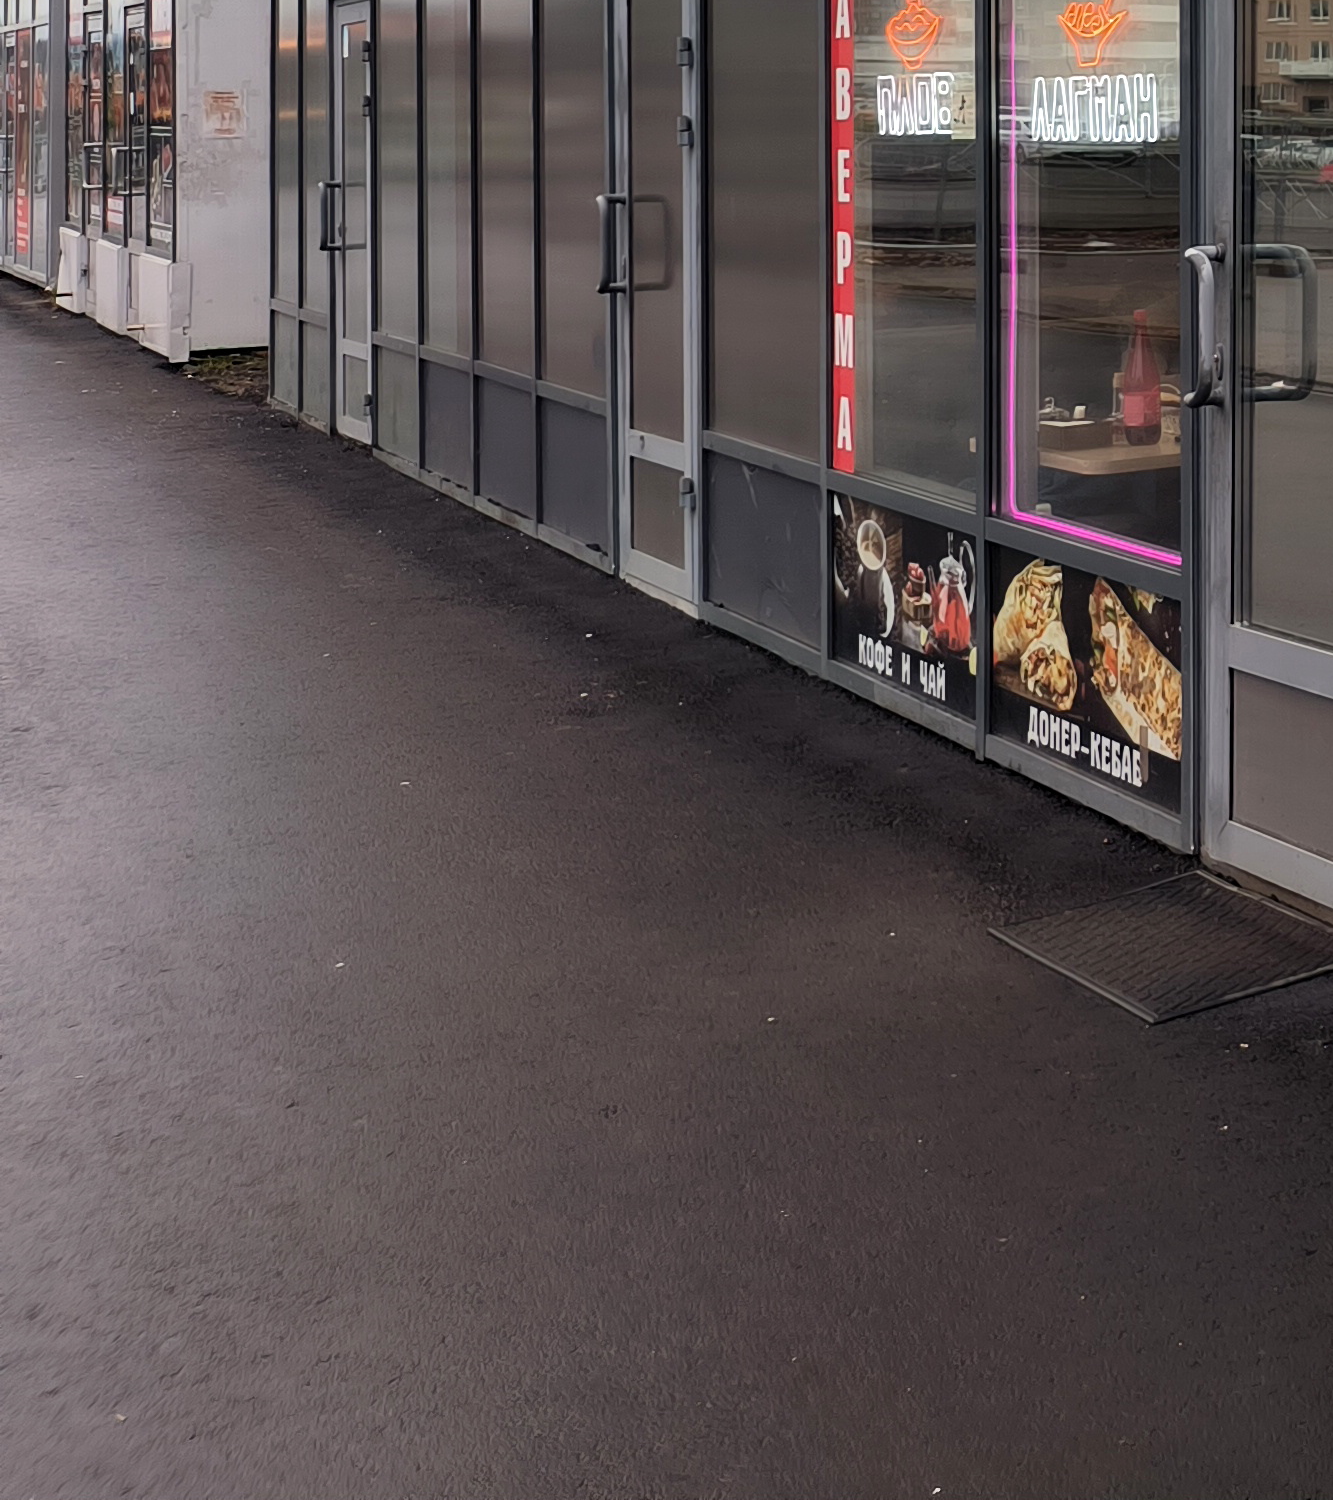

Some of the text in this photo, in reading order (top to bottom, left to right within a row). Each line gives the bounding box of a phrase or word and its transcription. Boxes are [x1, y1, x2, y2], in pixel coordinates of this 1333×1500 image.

[1031, 74, 1158, 143] ЛАГМАН
[858, 634, 946, 701] КОФЕ И ЧАЙ
[1027, 705, 1143, 788] ДОНЕР-КЕБАБ
